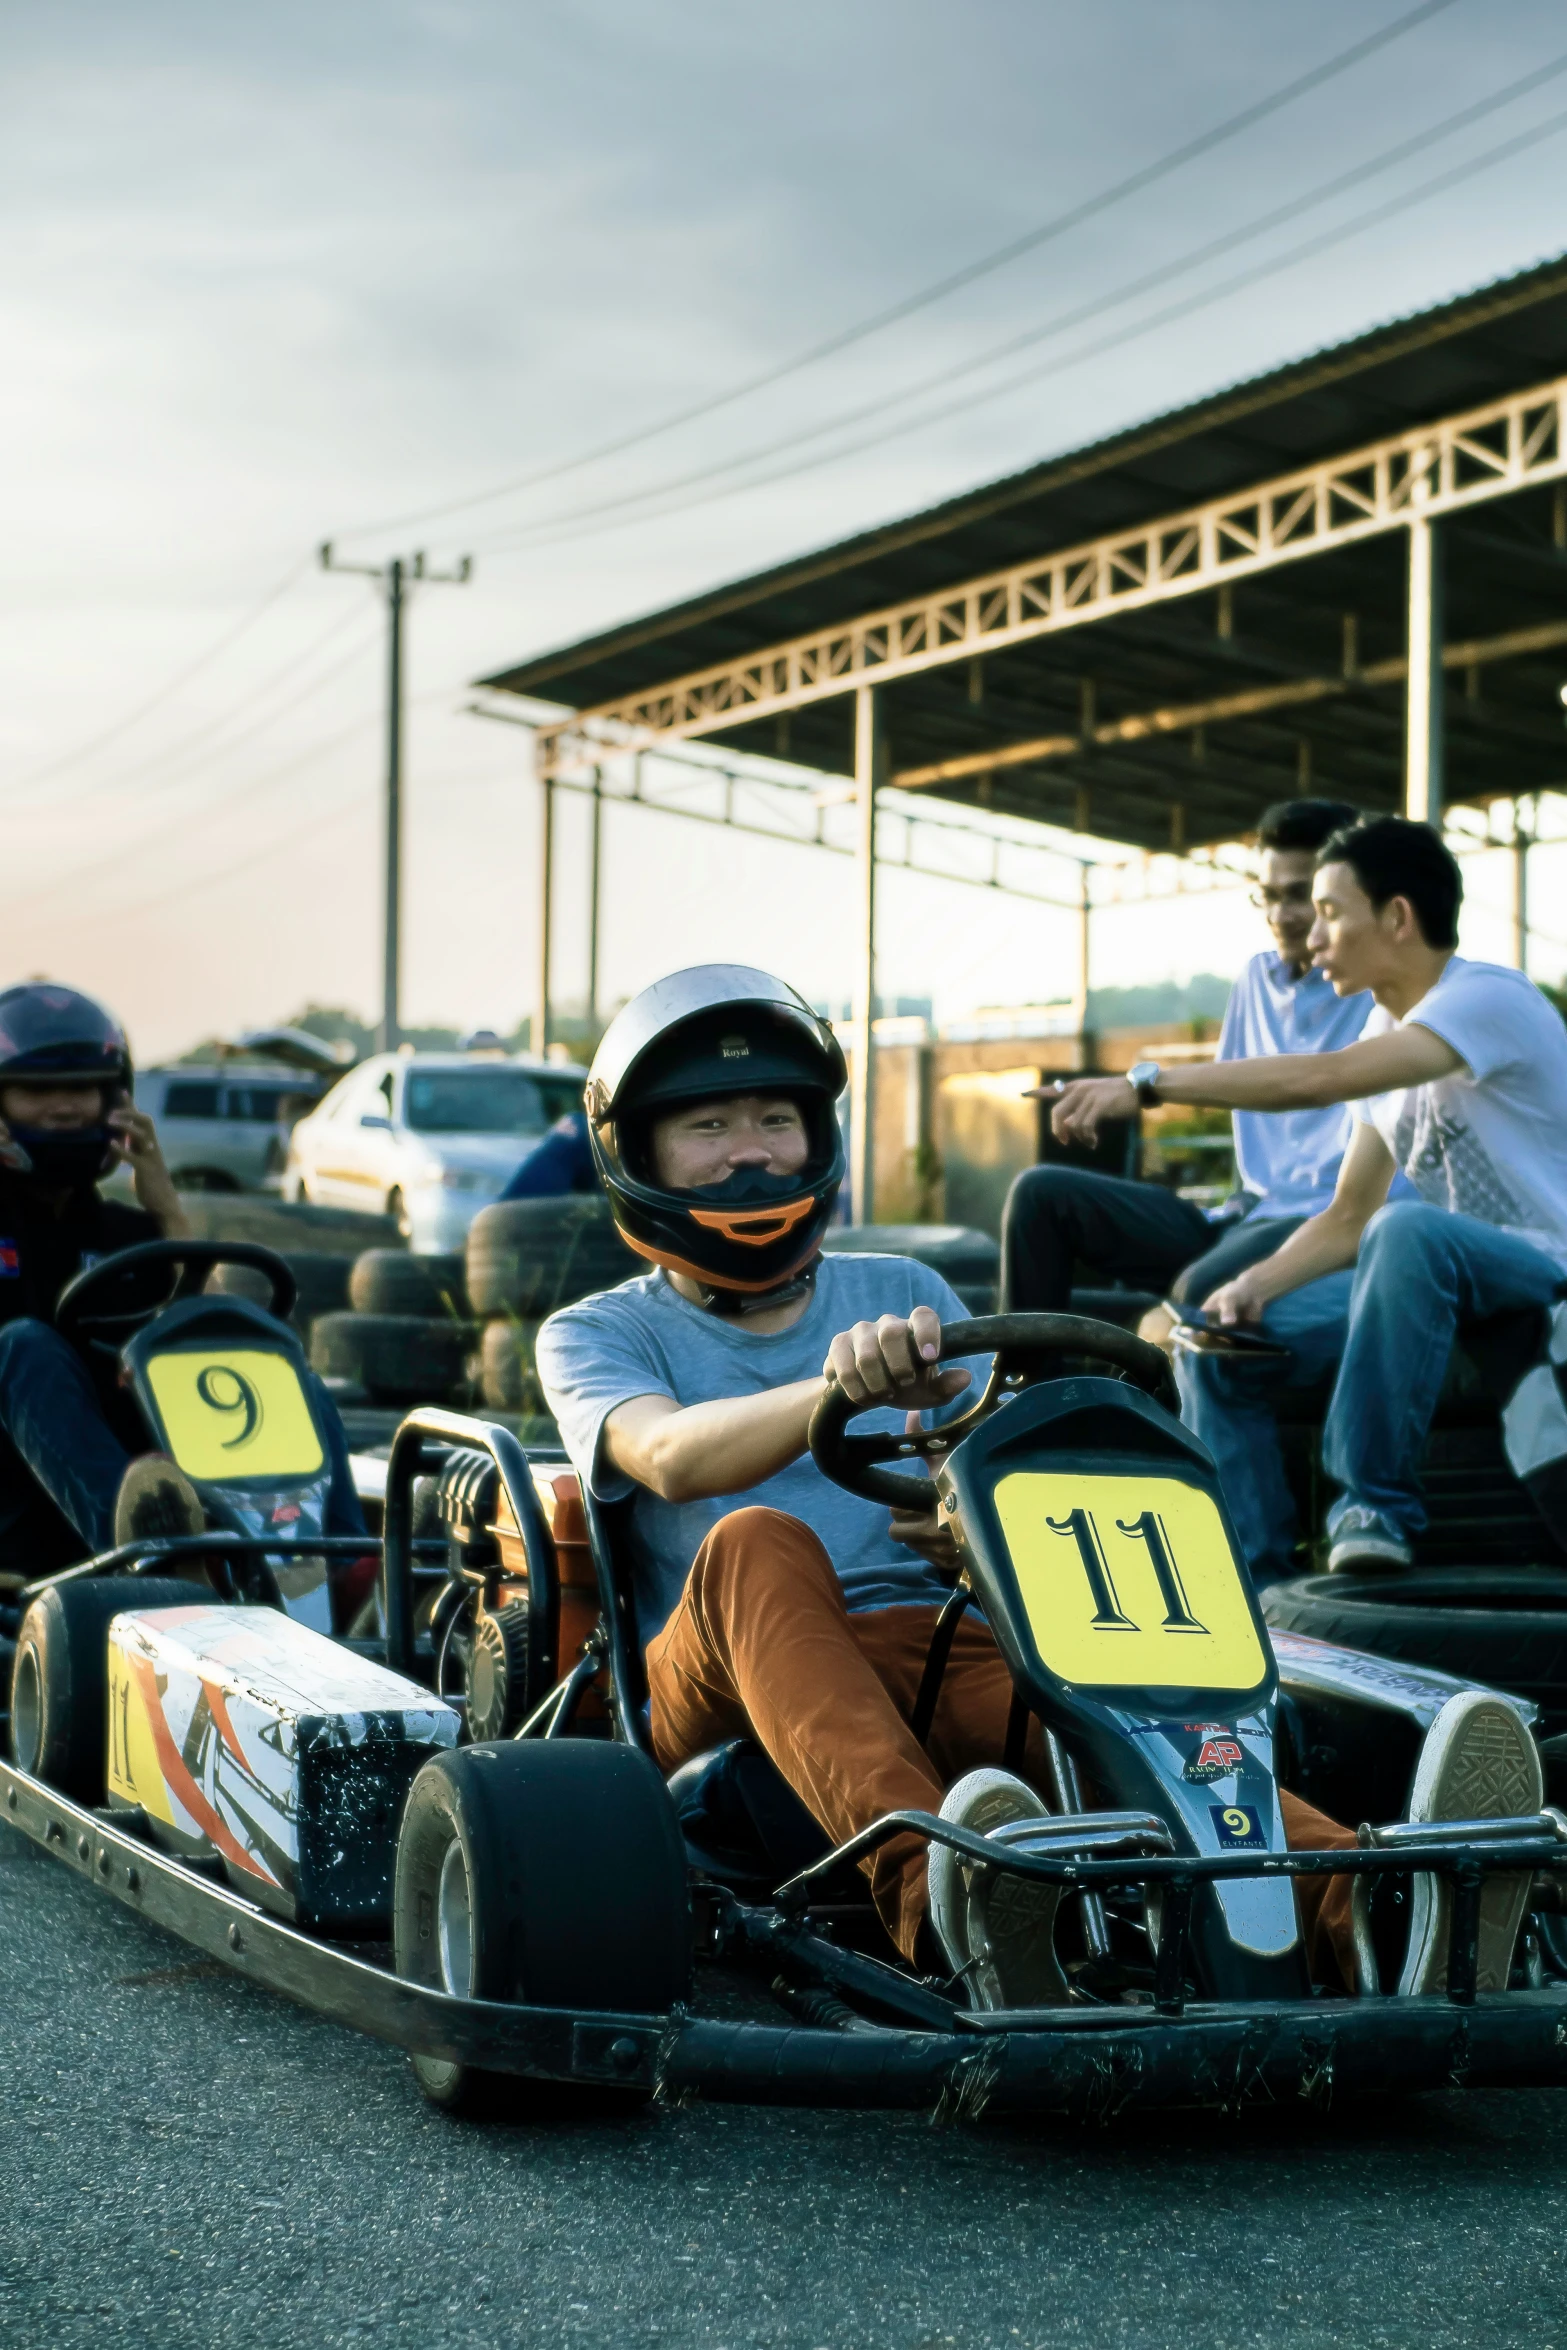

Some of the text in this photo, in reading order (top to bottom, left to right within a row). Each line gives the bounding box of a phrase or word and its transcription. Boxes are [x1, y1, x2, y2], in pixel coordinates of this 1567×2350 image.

[722, 1047, 749, 1059] Royal
[196, 1365, 264, 1453] 9
[1045, 1508, 1212, 1634] 11
[111, 1673, 138, 1792] 11
[1198, 1741, 1242, 1766] AP
